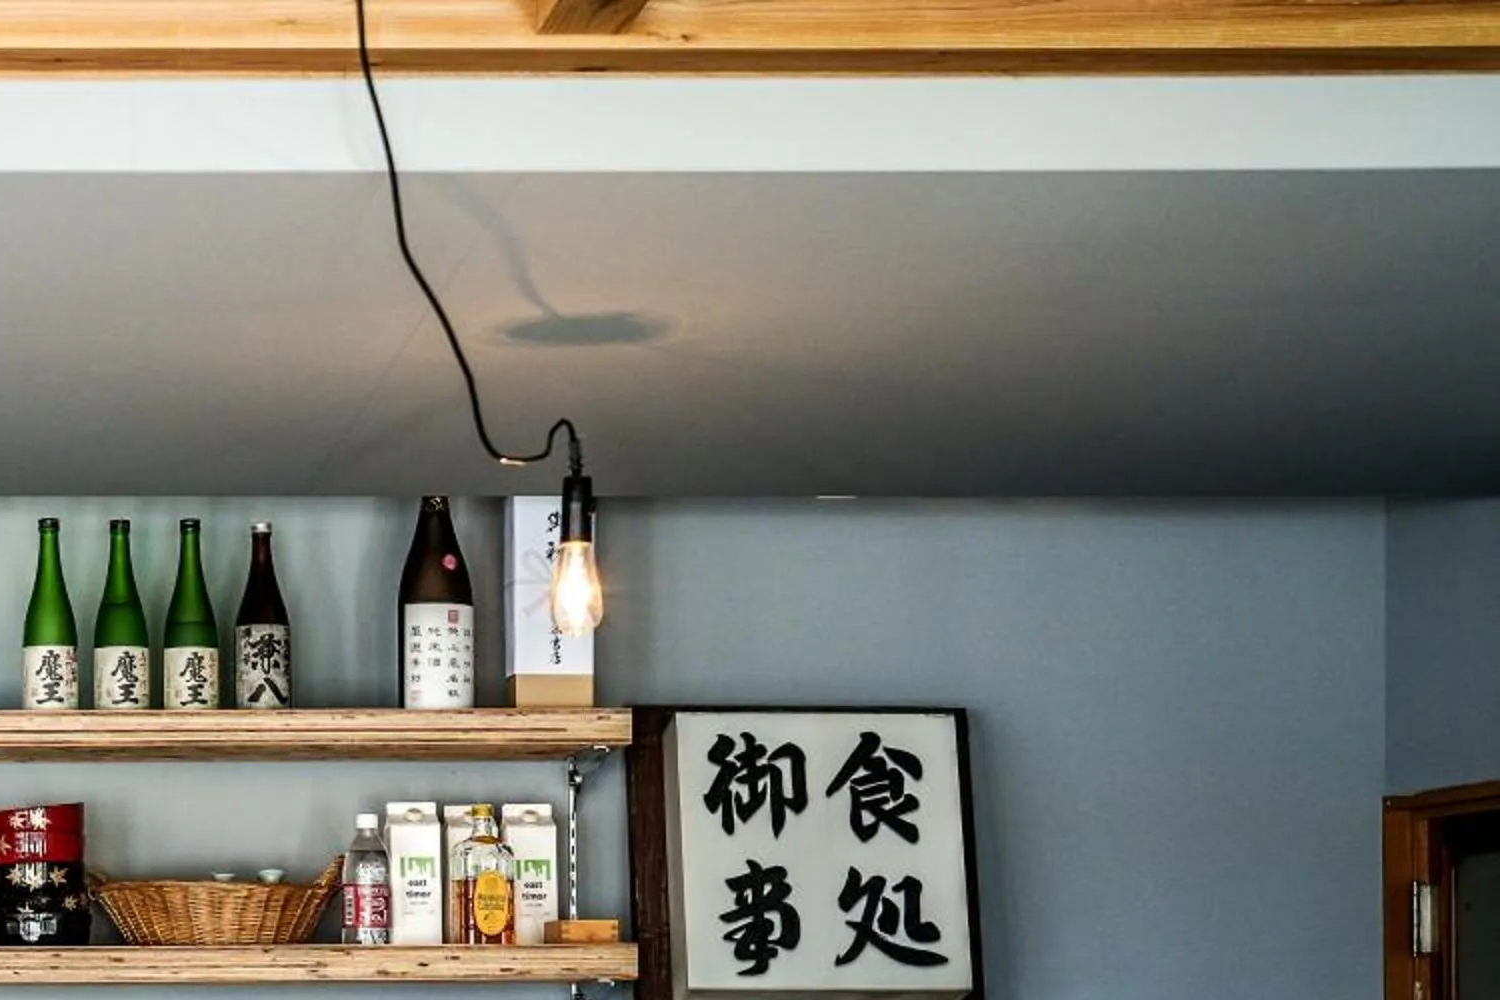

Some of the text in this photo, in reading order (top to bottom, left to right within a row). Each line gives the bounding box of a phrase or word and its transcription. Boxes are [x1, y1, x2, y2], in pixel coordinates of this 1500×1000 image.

[35, 649, 65, 705] 魔王
[111, 650, 139, 705] 魔王
[180, 651, 208, 706] 魔王
